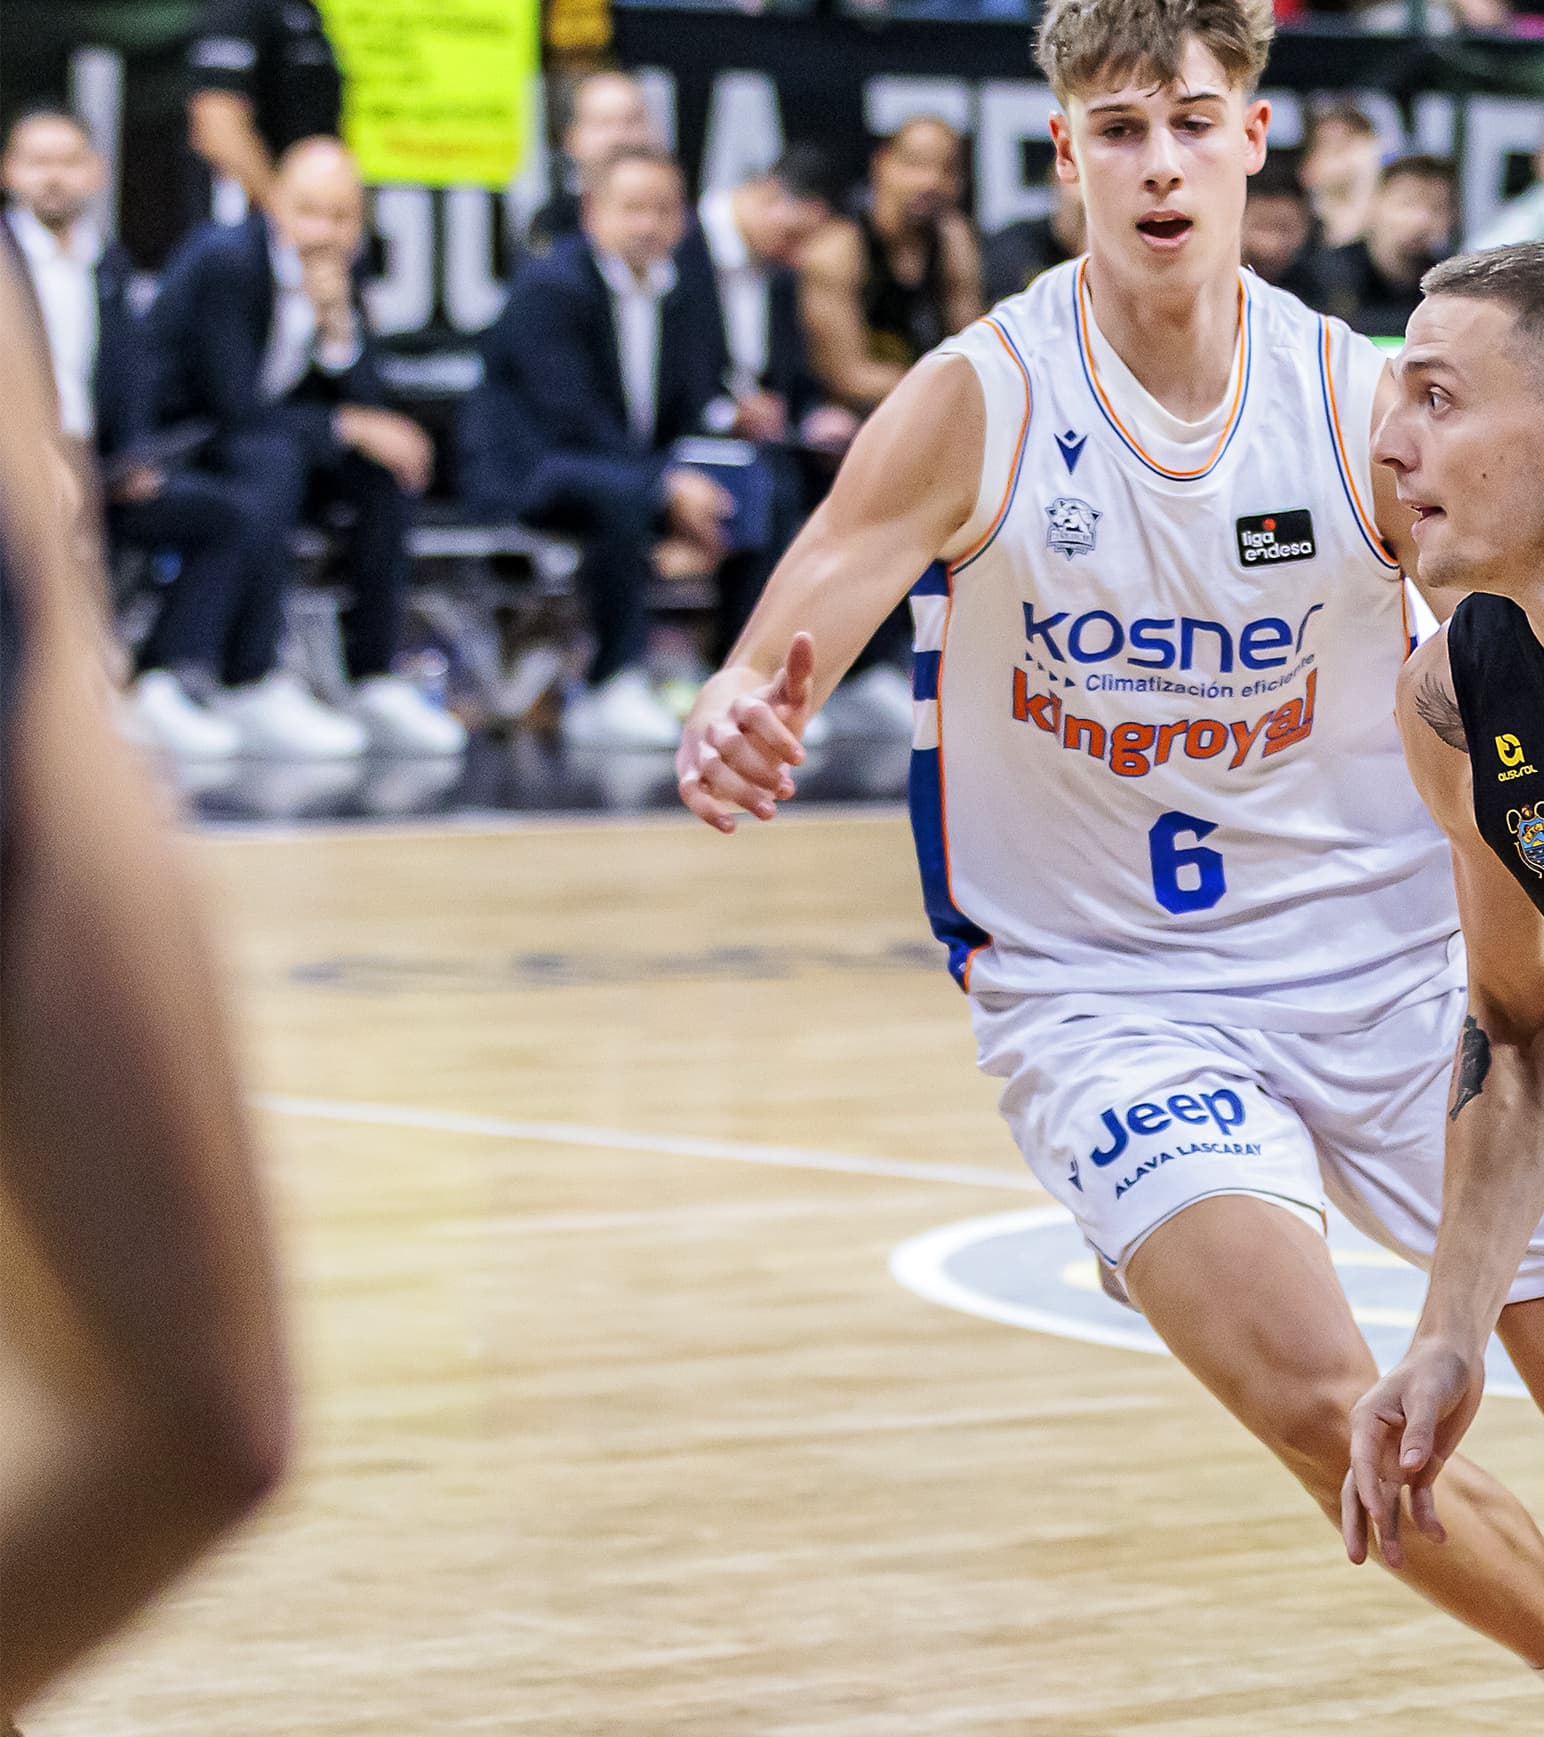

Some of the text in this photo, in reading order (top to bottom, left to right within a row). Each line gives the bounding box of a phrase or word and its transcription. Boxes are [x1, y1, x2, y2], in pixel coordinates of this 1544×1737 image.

[1241, 529, 1275, 550] liga
[1244, 540, 1313, 562] endesa
[1022, 600, 1325, 673] kosner
[1086, 673, 1233, 698] Climatización
[1012, 666, 1318, 777] kingroyal
[1148, 810, 1227, 915] 6
[1089, 1089, 1246, 1168] Jeep
[1176, 1143, 1262, 1156] LASCARAY
